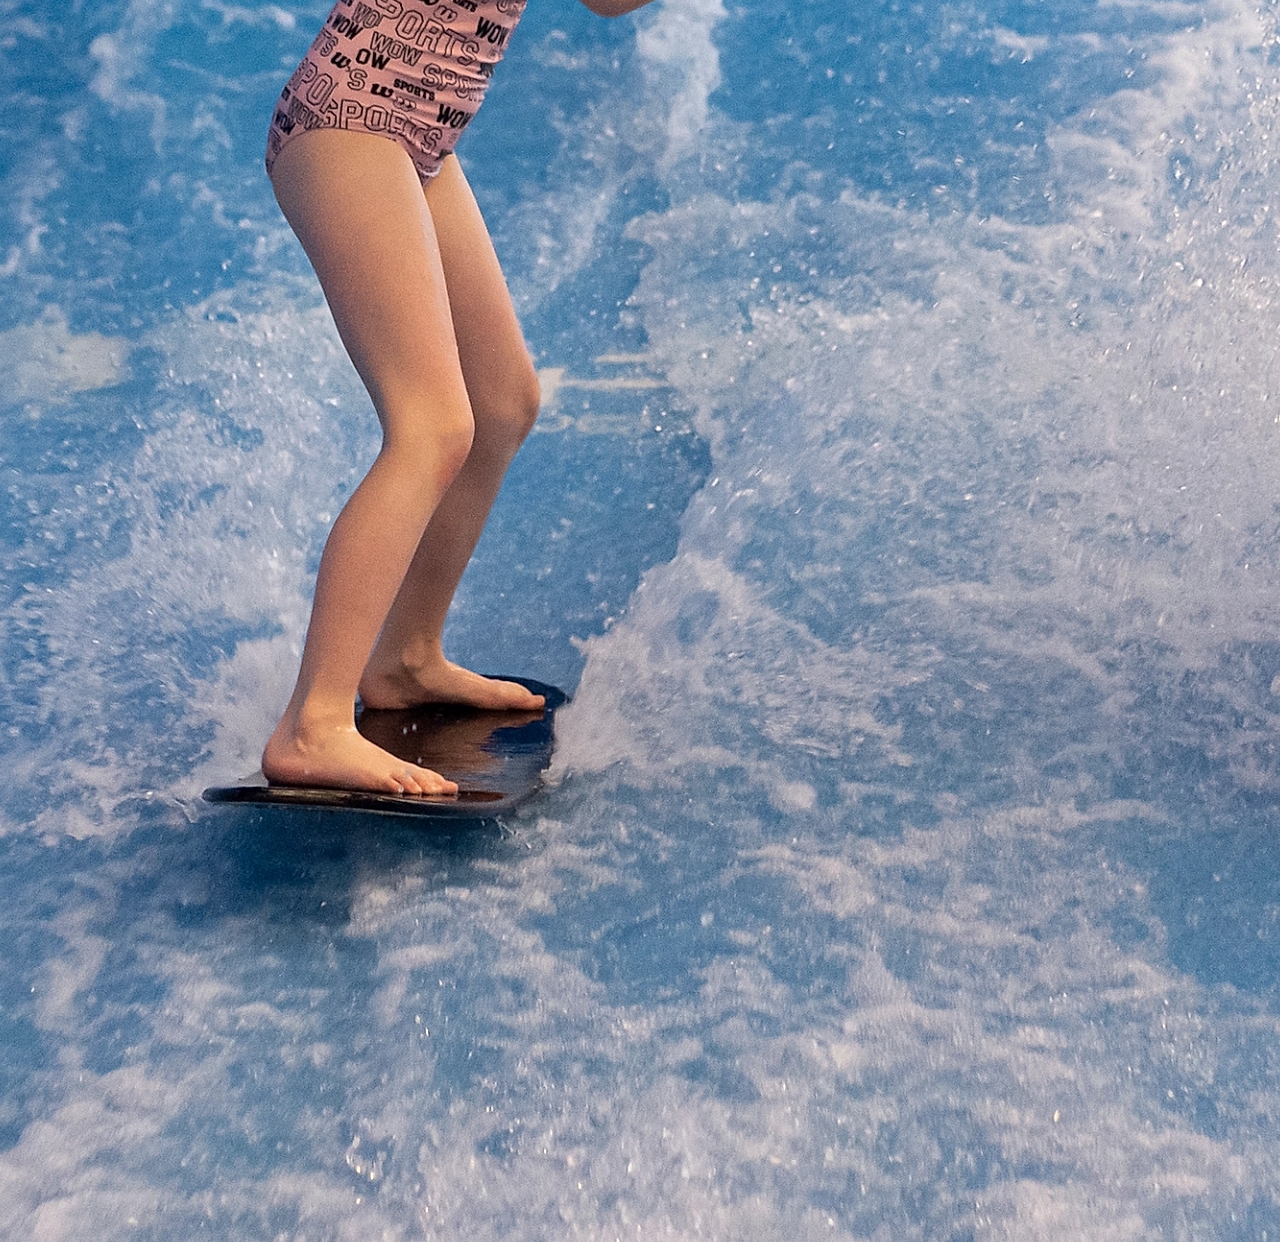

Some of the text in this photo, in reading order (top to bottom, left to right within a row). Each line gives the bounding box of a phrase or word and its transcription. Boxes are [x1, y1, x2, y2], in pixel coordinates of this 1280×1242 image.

[331, 13, 364, 40] WOW
[369, 31, 423, 67] WOW
[393, 78, 436, 101] SPORTS
